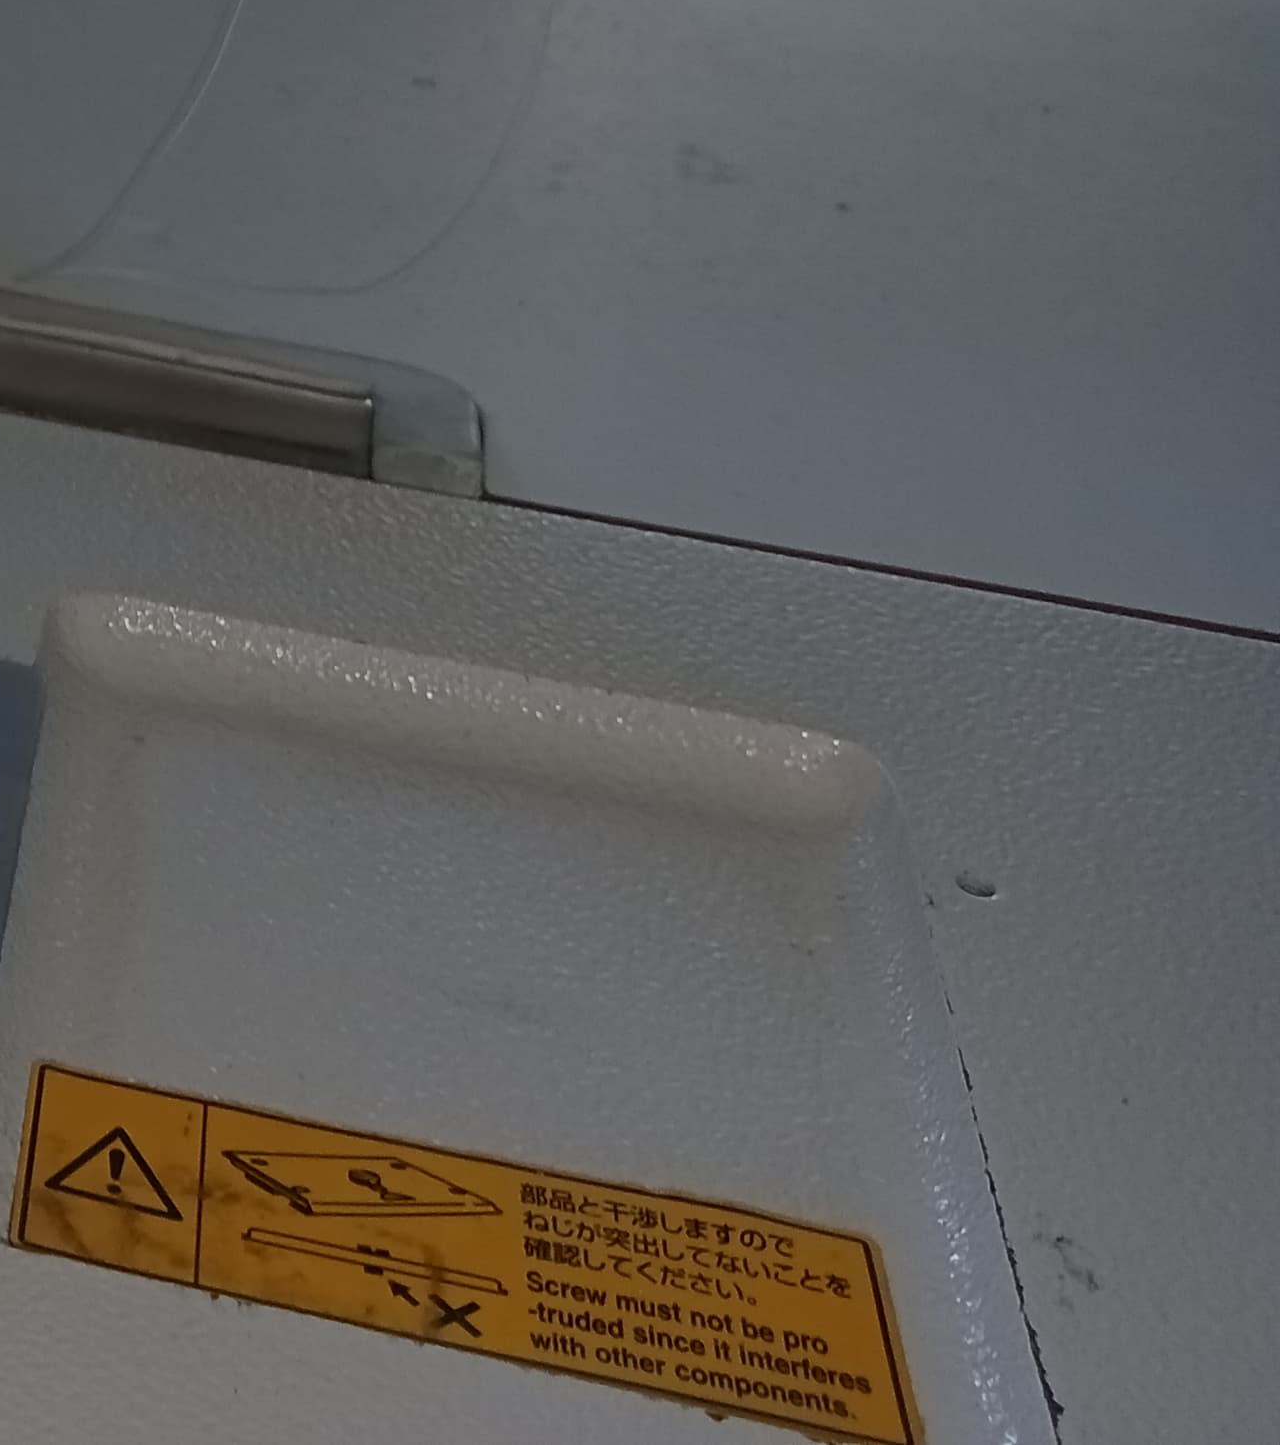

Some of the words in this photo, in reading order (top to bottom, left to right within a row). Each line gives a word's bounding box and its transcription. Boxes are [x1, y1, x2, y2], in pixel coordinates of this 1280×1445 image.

[526, 1271, 606, 1306] Screw
[616, 1294, 682, 1323] must
[690, 1310, 734, 1334] not
[741, 1317, 774, 1343] be
[783, 1330, 828, 1355] pro
[528, 1302, 624, 1339] -truded
[633, 1324, 706, 1356] since
[713, 1338, 732, 1362] it
[739, 1345, 872, 1395] interferes
[530, 1332, 586, 1359] with
[595, 1347, 666, 1376] other
[675, 1363, 858, 1420] components.
